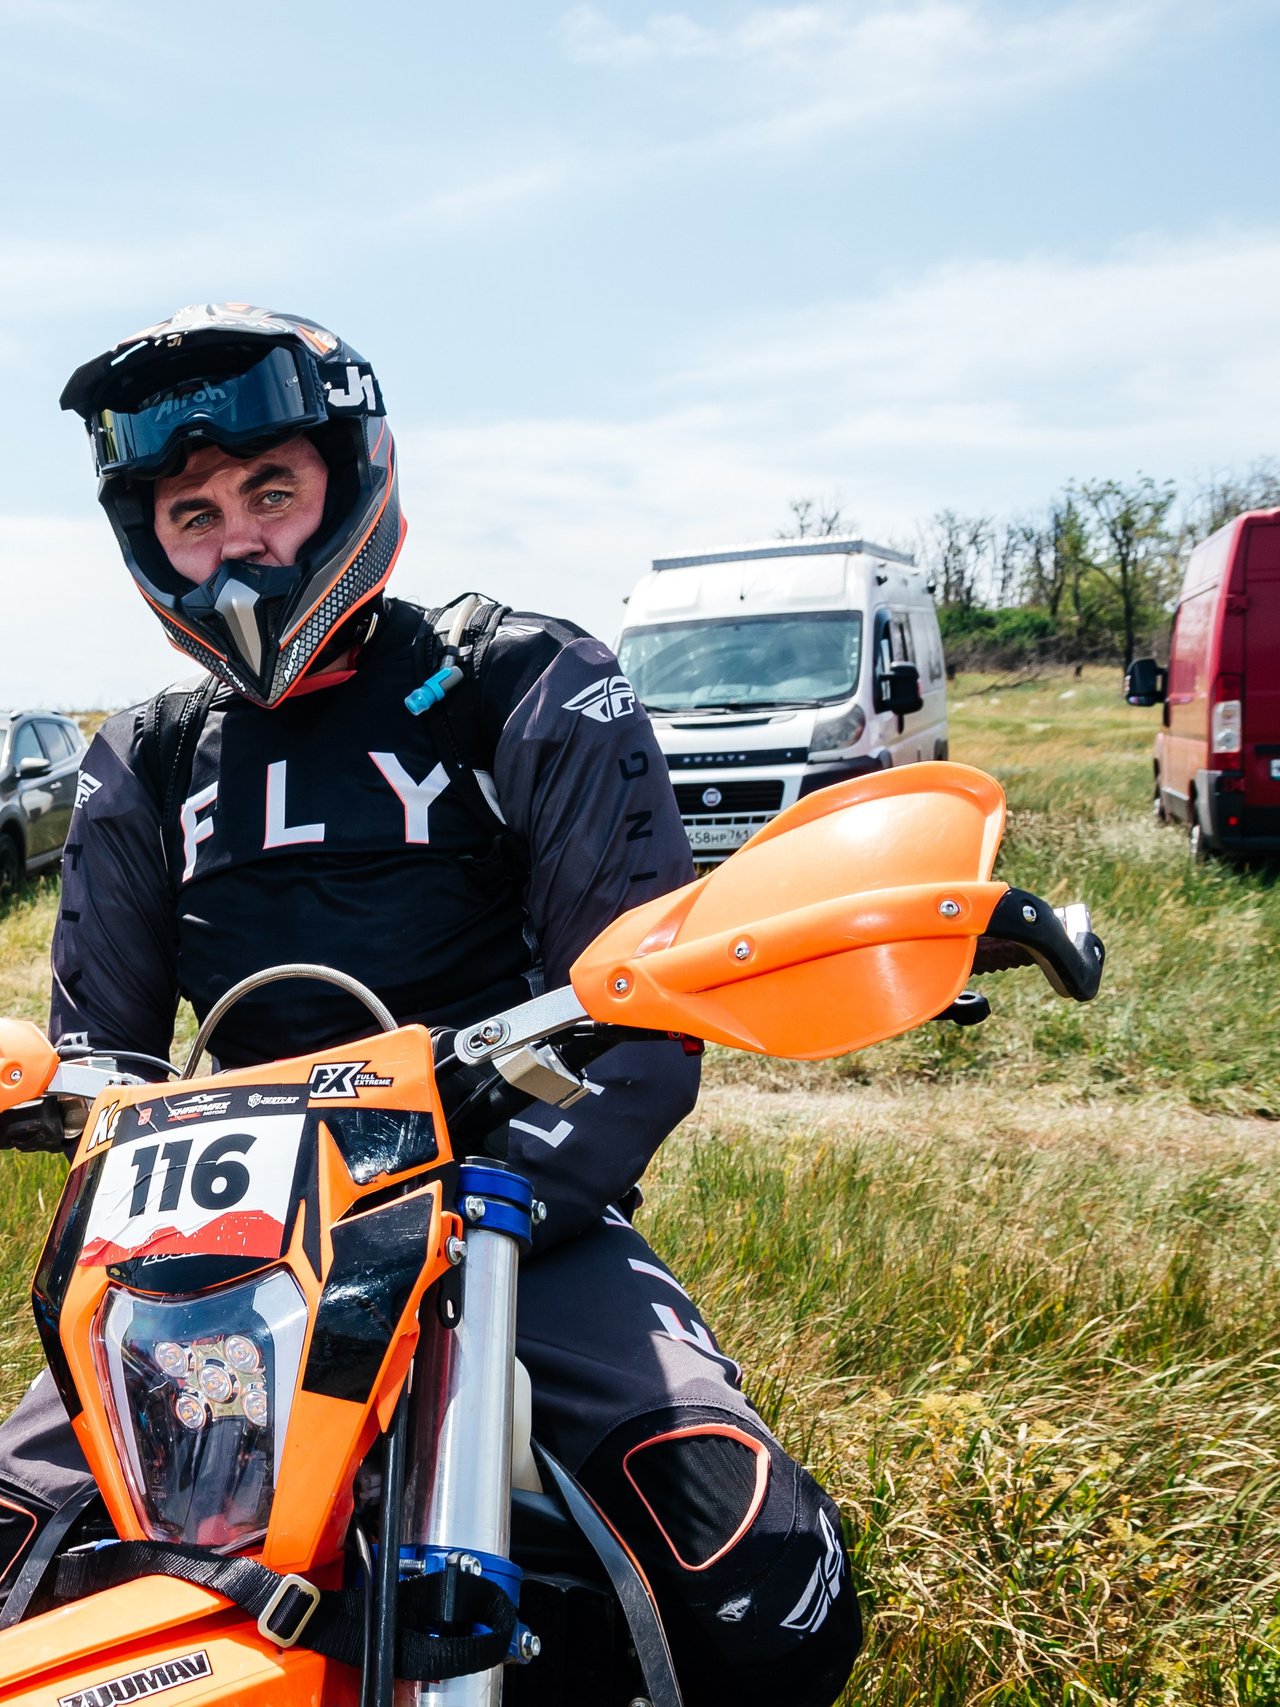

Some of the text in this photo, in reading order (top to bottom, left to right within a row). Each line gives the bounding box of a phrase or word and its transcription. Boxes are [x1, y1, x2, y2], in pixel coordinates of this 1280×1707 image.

[155, 381, 226, 423] Airoh
[219, 660, 247, 692] Airoh
[283, 639, 300, 683] Airoh
[181, 752, 451, 883] FLY
[687, 832, 727, 844] 458НР
[168, 1102, 231, 1118] SHARMAX
[203, 1109, 227, 1117] MOTORS
[128, 1133, 257, 1219] 116
